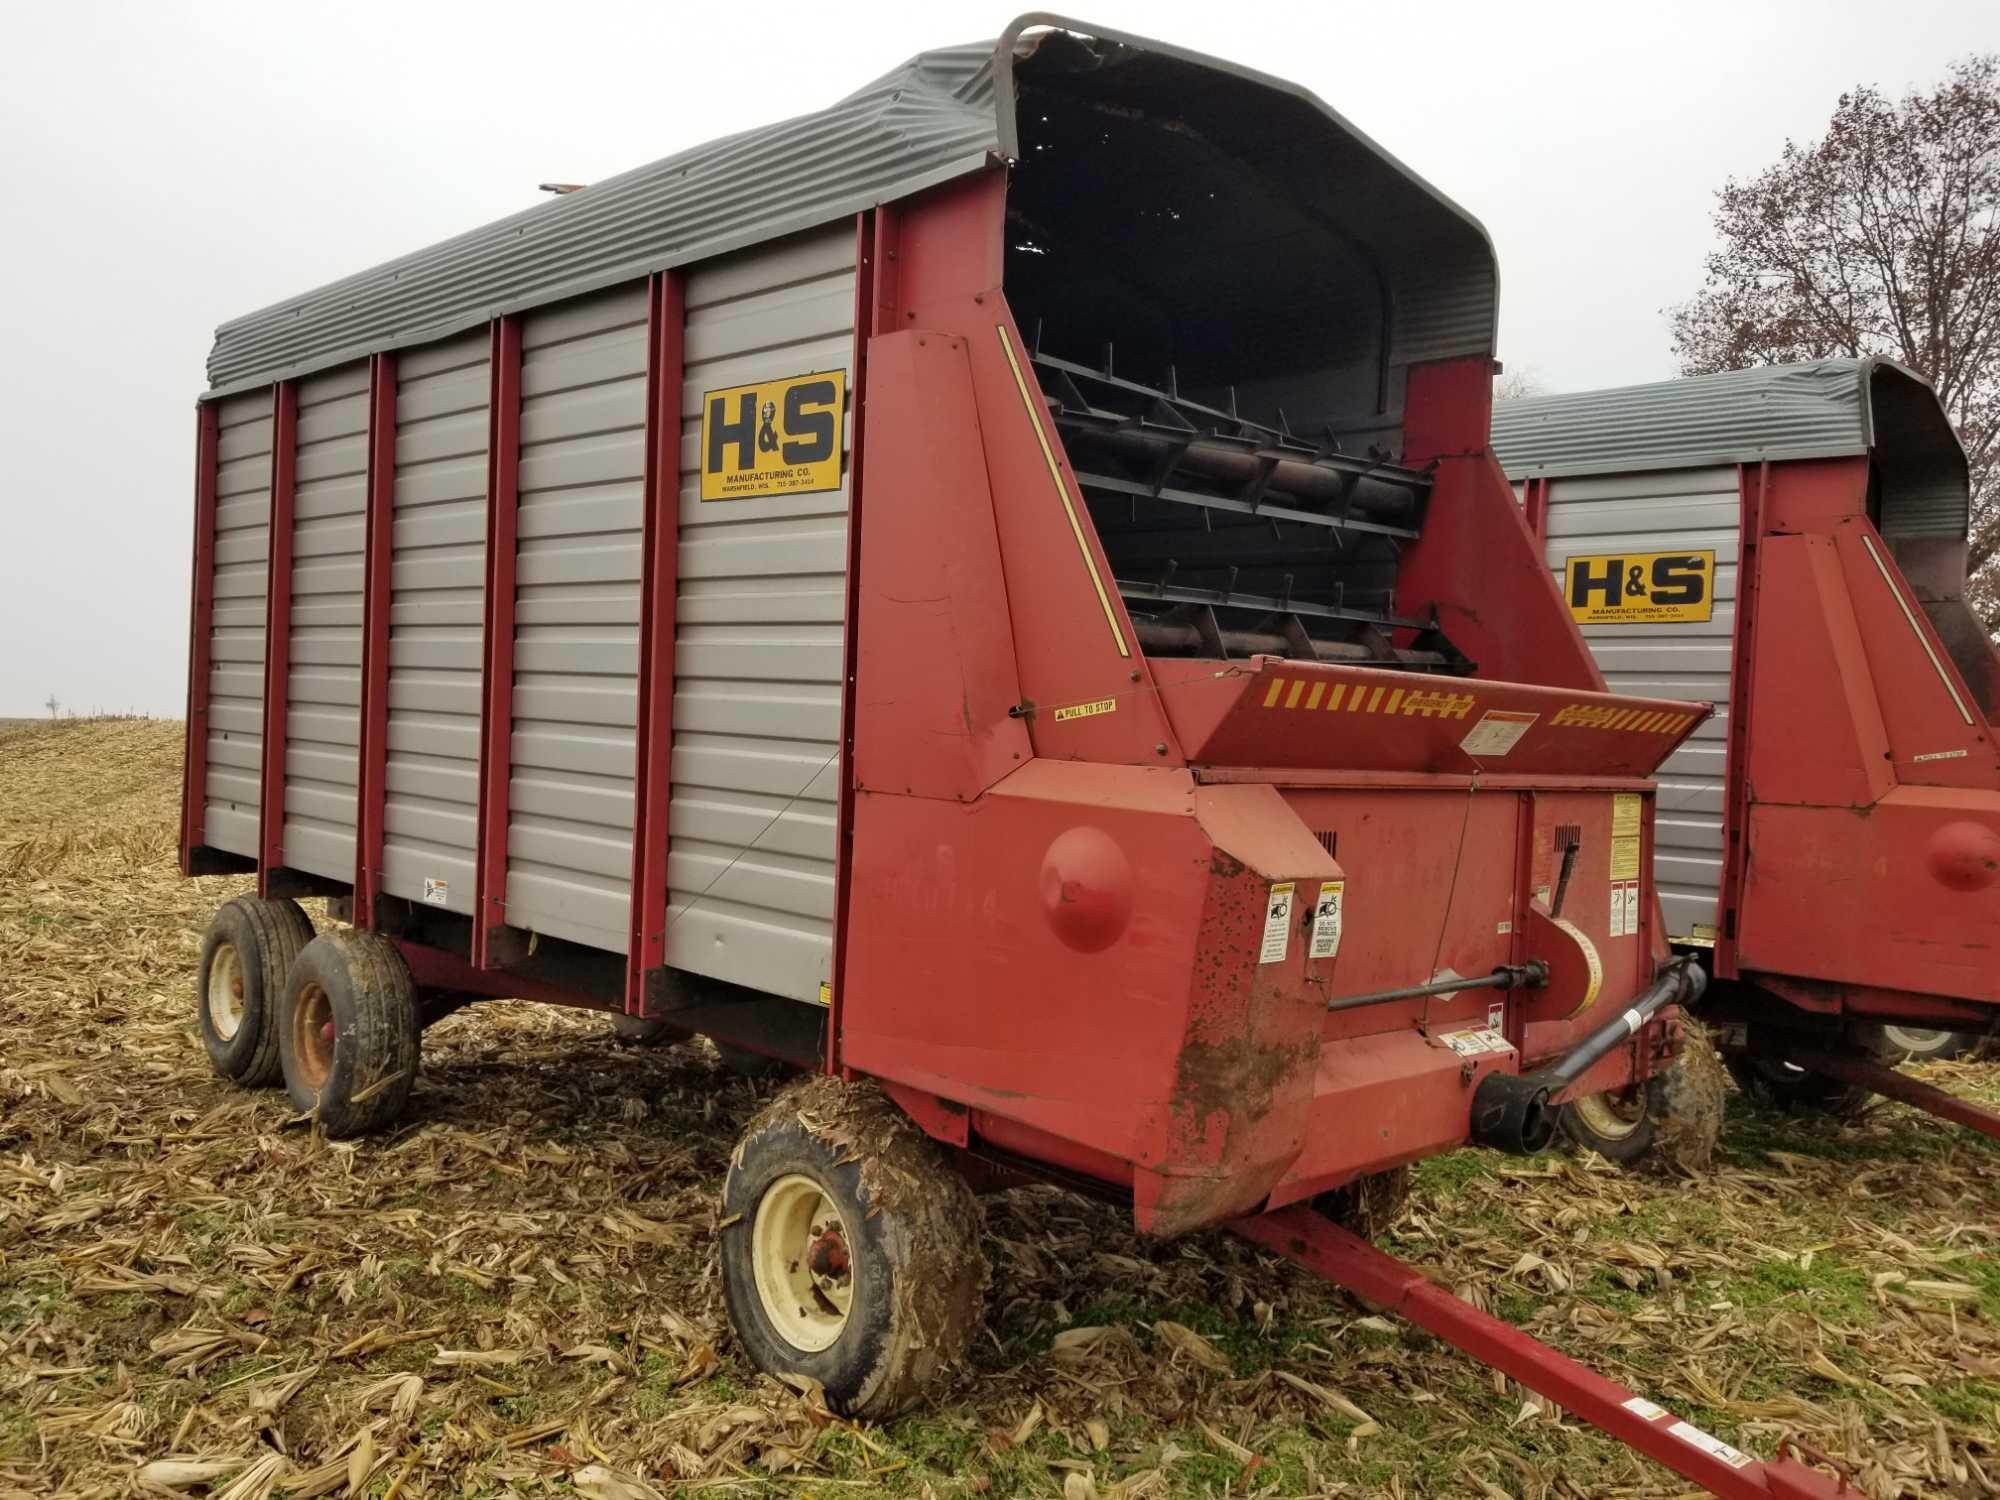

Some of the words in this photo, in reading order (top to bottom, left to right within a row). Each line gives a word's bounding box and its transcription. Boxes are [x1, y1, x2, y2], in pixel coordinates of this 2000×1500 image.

[708, 381, 836, 474] H&S
[726, 469, 793, 484] MANUFACTURING
[797, 467, 811, 477] CO.
[1572, 556, 1706, 608] H&S
[1592, 607, 1662, 615] MANUFACTURING
[1065, 707, 1081, 718] PULL
[1084, 704, 1094, 714] TO
[1096, 701, 1113, 713] STOP
